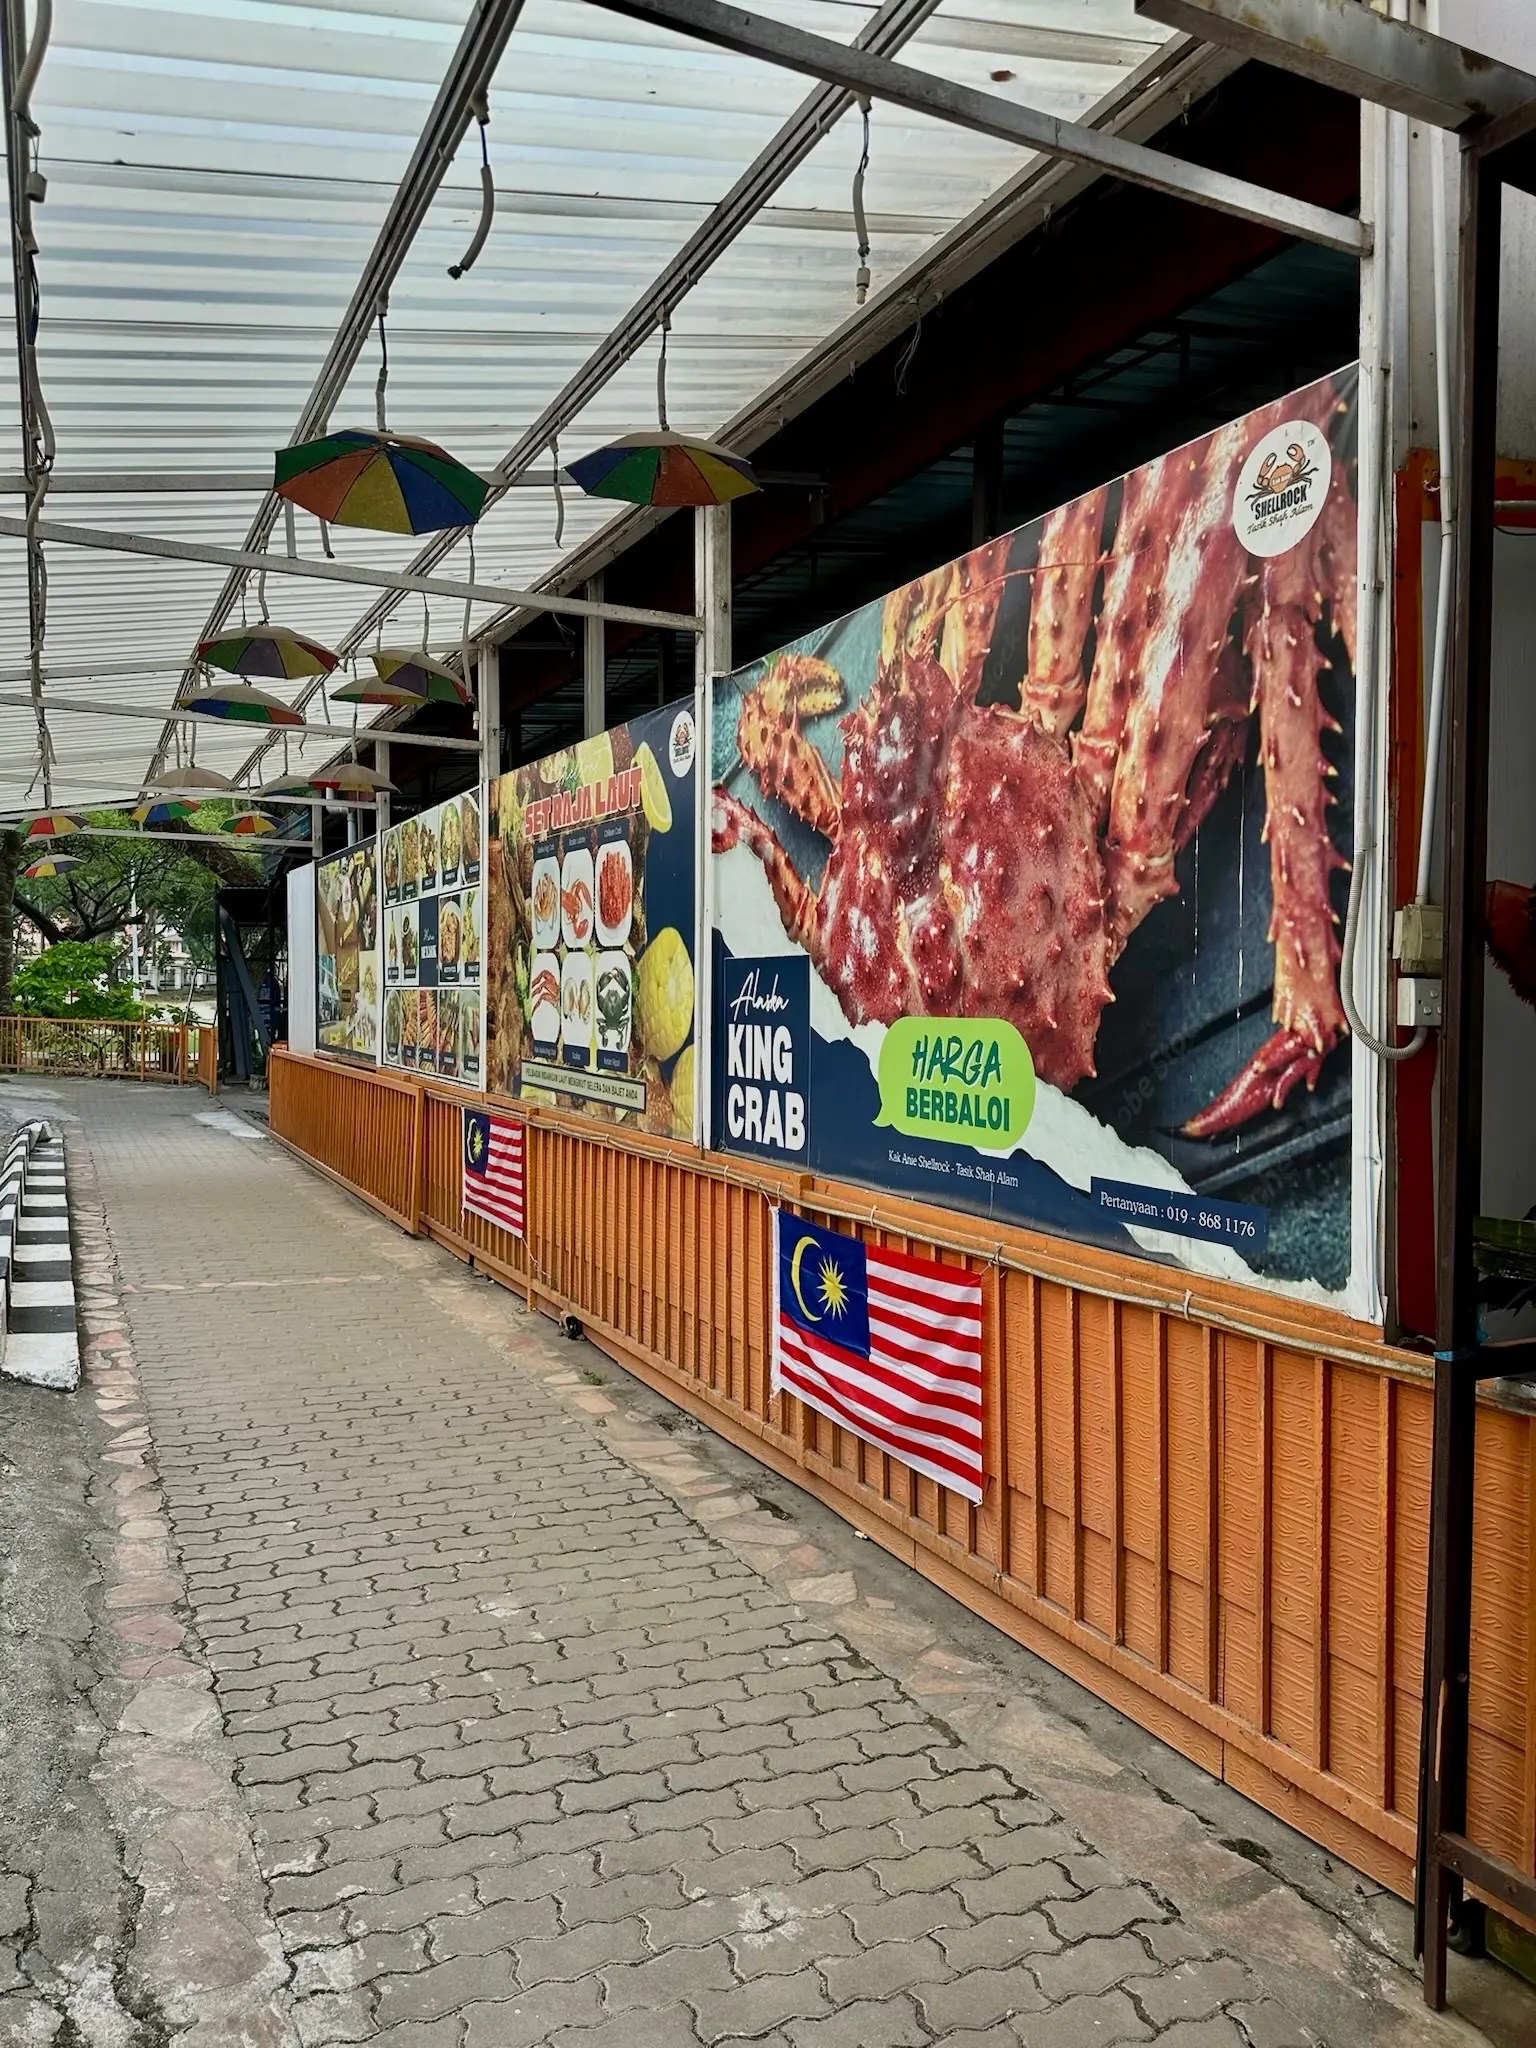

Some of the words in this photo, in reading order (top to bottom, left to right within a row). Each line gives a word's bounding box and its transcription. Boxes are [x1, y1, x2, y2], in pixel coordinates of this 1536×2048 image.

[1247, 520, 1268, 535] Tasik
[1268, 511, 1288, 527] Shah
[1290, 503, 1314, 518] Alam
[1254, 483, 1308, 521] SHELLROCK
[524, 795, 552, 838] SET
[551, 783, 592, 830] RAJA
[594, 766, 643, 817] LAUT
[730, 968, 789, 1021] Alaska
[726, 1022, 793, 1085] KING
[912, 1035, 1002, 1088] HARGA
[726, 1083, 806, 1151] CRAB
[906, 1087, 1010, 1132] BERBALOI
[888, 1149, 902, 1164] Kak
[902, 1153, 918, 1166] Anie
[917, 1156, 951, 1173] Shellrock
[955, 1162, 975, 1178] Tasik
[974, 1166, 996, 1183] Shah
[996, 1170, 1019, 1188] Alam
[1100, 1191, 1158, 1217] Pertanyaan
[1166, 1206, 1188, 1224] 019
[1199, 1211, 1222, 1230] 868
[1225, 1217, 1256, 1237] 1176
